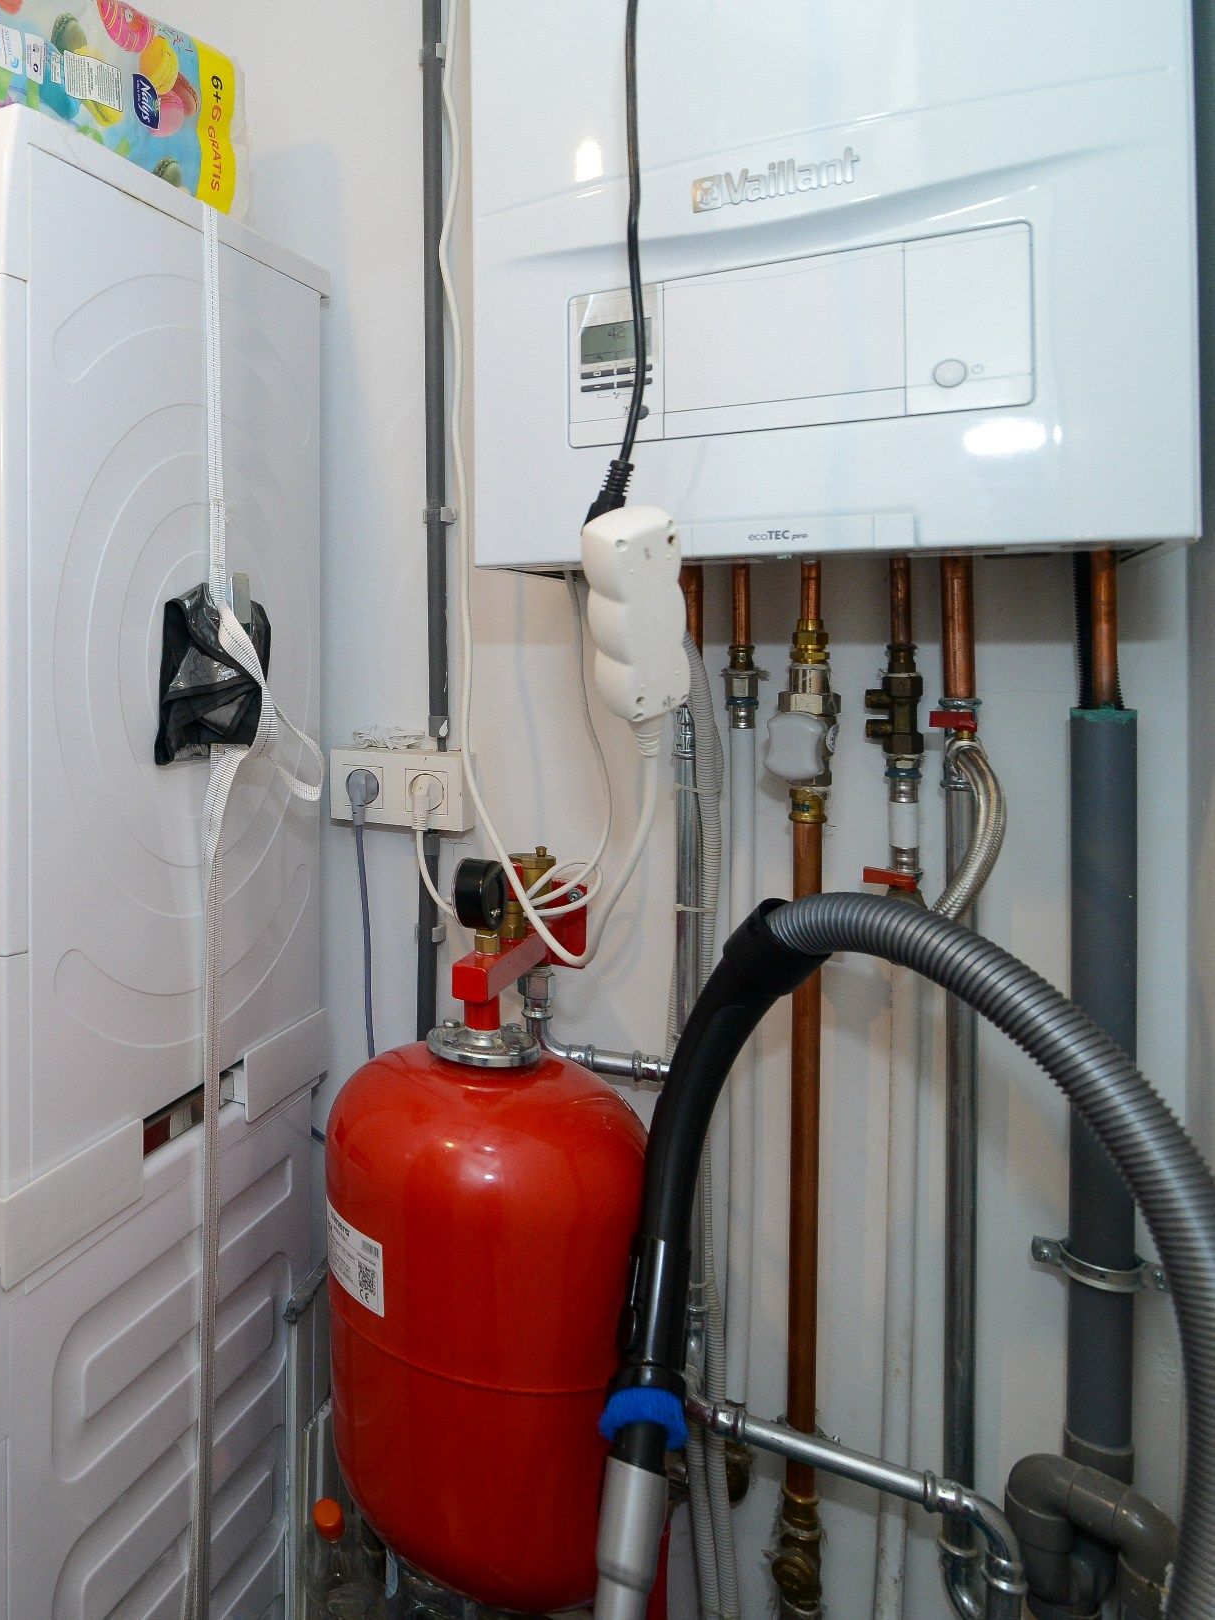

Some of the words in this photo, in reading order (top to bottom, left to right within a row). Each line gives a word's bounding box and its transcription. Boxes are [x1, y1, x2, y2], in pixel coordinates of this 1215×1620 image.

[207, 125, 222, 191] GRATIS
[723, 146, 860, 206] Vaillant
[748, 530, 790, 541] ecoTEC
[791, 533, 808, 541] pro
